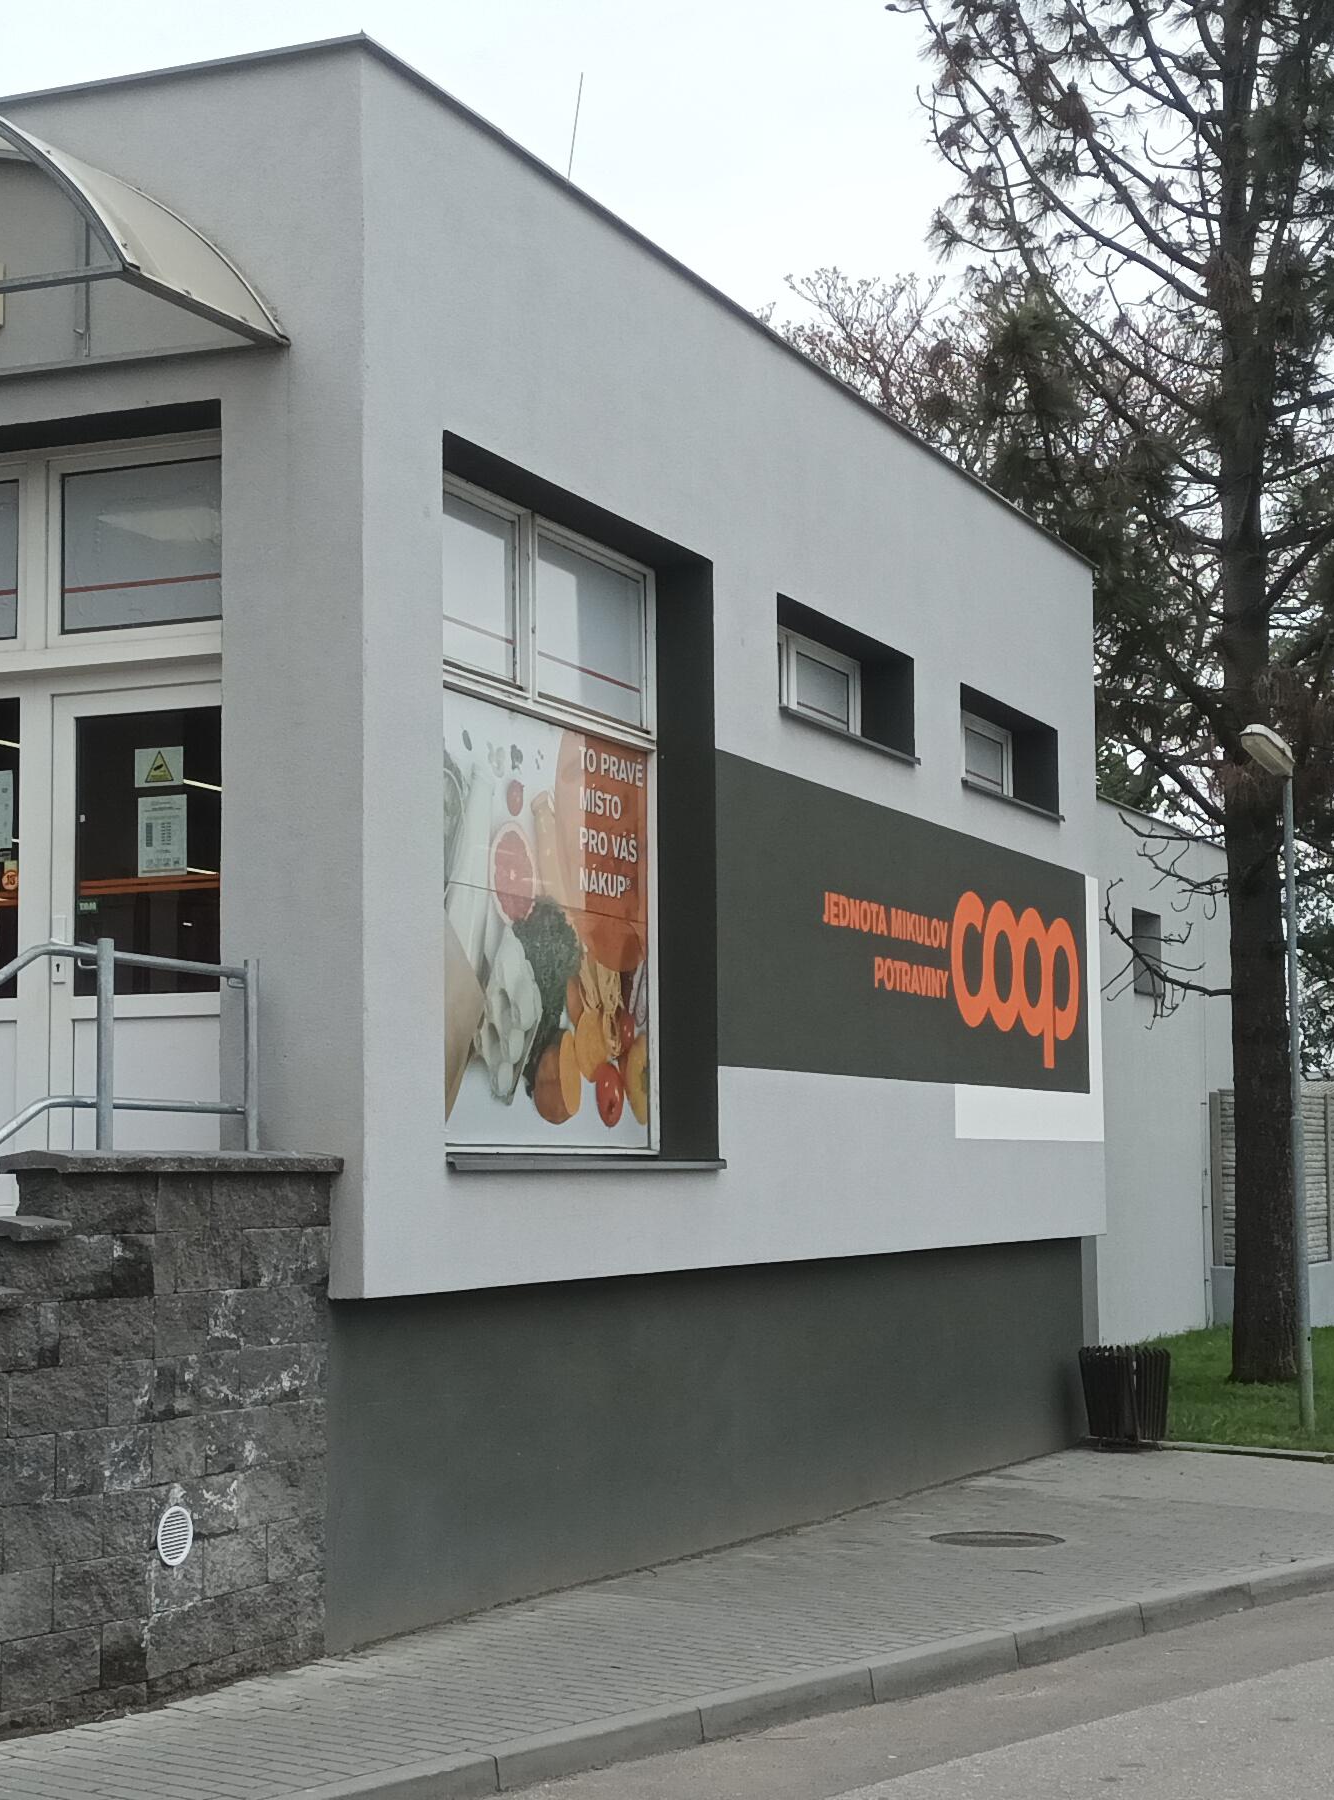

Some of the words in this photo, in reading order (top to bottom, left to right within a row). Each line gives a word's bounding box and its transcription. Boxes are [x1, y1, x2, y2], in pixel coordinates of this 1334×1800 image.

[579, 745, 597, 773] TO
[601, 752, 644, 788] PRAVÉ
[579, 783, 621, 820] MÍSTO
[579, 826, 608, 856] PRO
[611, 832, 638, 864] VÁŠ
[822, 891, 888, 936] JEDNOTA
[891, 907, 949, 949] MIKULOV
[874, 956, 949, 999] POTRAVINY
[951, 891, 1079, 1069] coop
